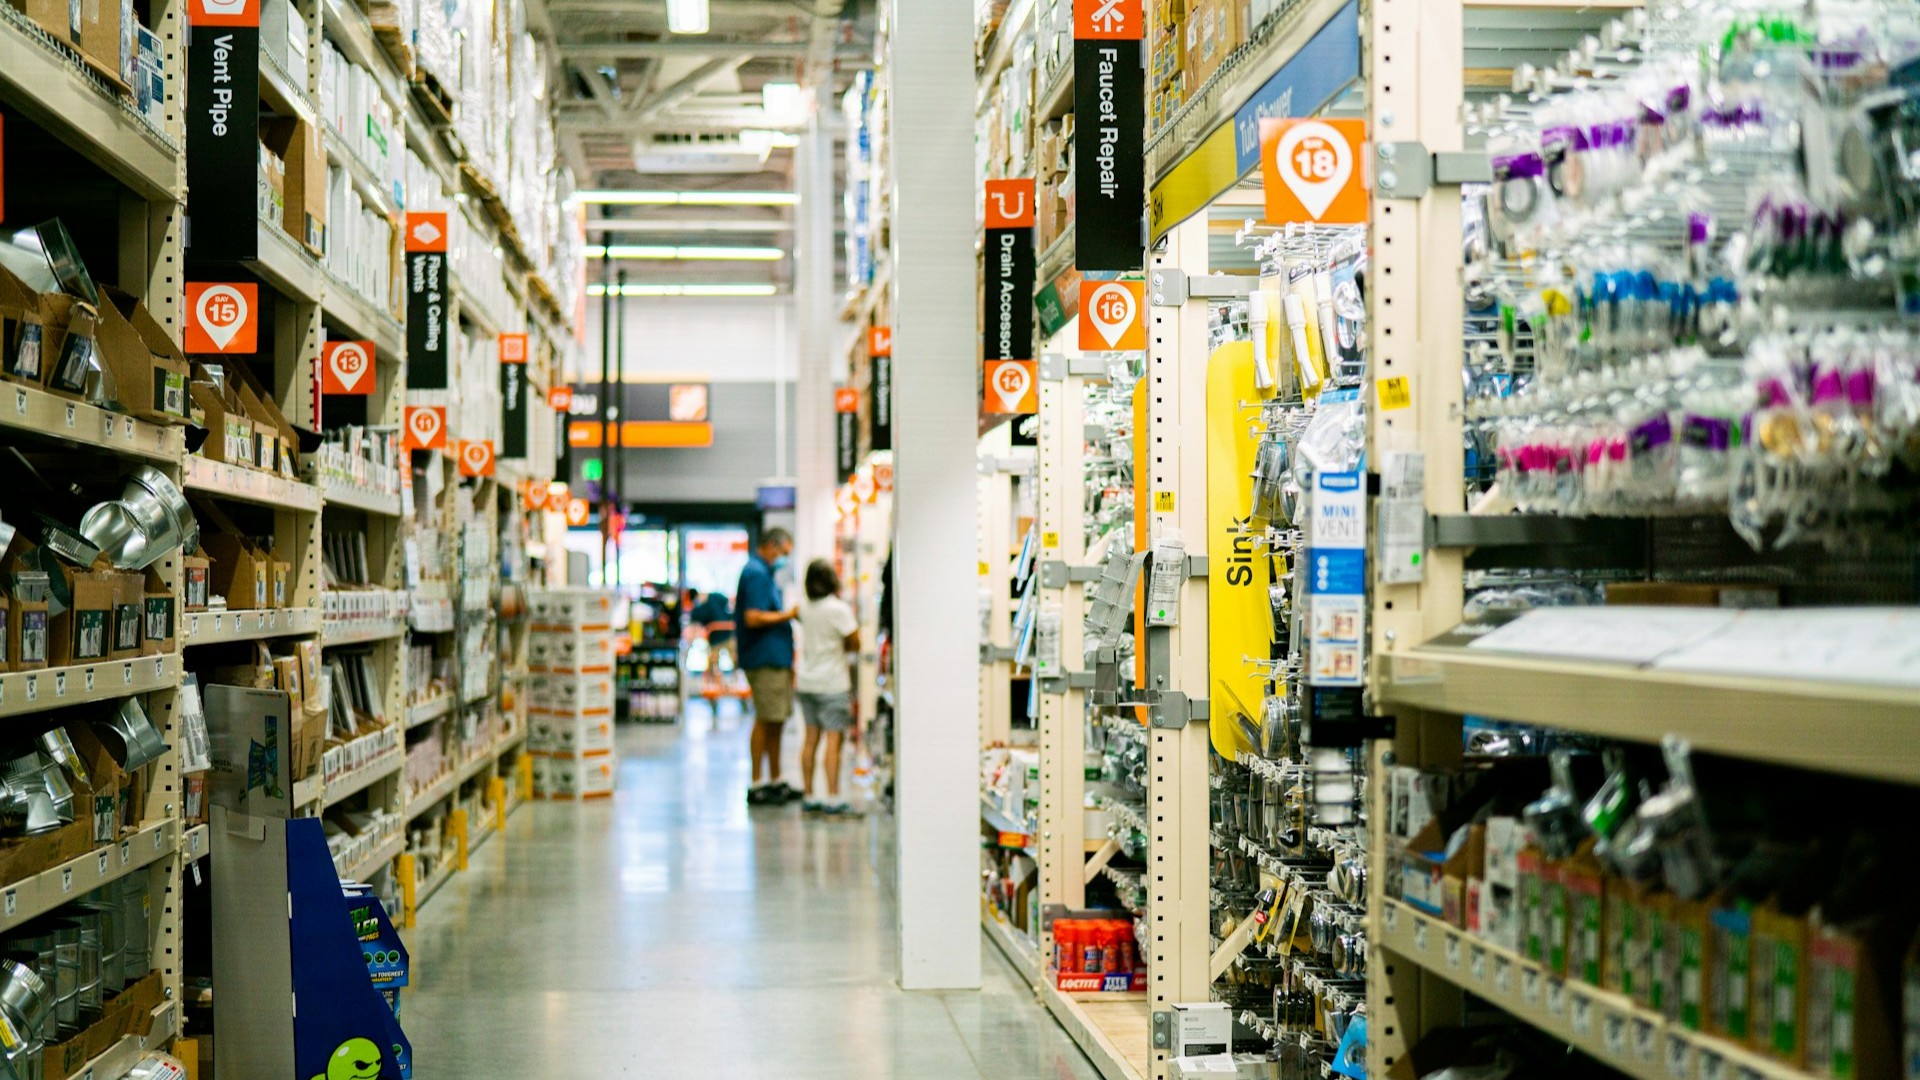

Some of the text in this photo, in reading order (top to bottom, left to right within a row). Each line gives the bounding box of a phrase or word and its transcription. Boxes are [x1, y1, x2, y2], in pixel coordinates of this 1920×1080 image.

[208, 34, 234, 137] Vent Pipe
[1096, 48, 1119, 199] Faucet Repair
[1295, 150, 1336, 178] 18
[1153, 192, 1164, 228] Sink
[1000, 234, 1015, 277] Drain
[414, 254, 426, 293] Vents
[424, 254, 441, 351] Floor & Ceiling
[1100, 302, 1126, 320] 16
[209, 304, 236, 322] 15
[339, 356, 360, 371] 13
[1001, 375, 1022, 390] 14
[418, 418, 432, 429] 11
[1322, 505, 1357, 518] MINI
[1317, 519, 1360, 538] VENT
[1226, 516, 1253, 587] Sink
[355, 917, 379, 935] LER
[1060, 978, 1100, 989] LOCTITE
[1105, 976, 1128, 985] TITE
